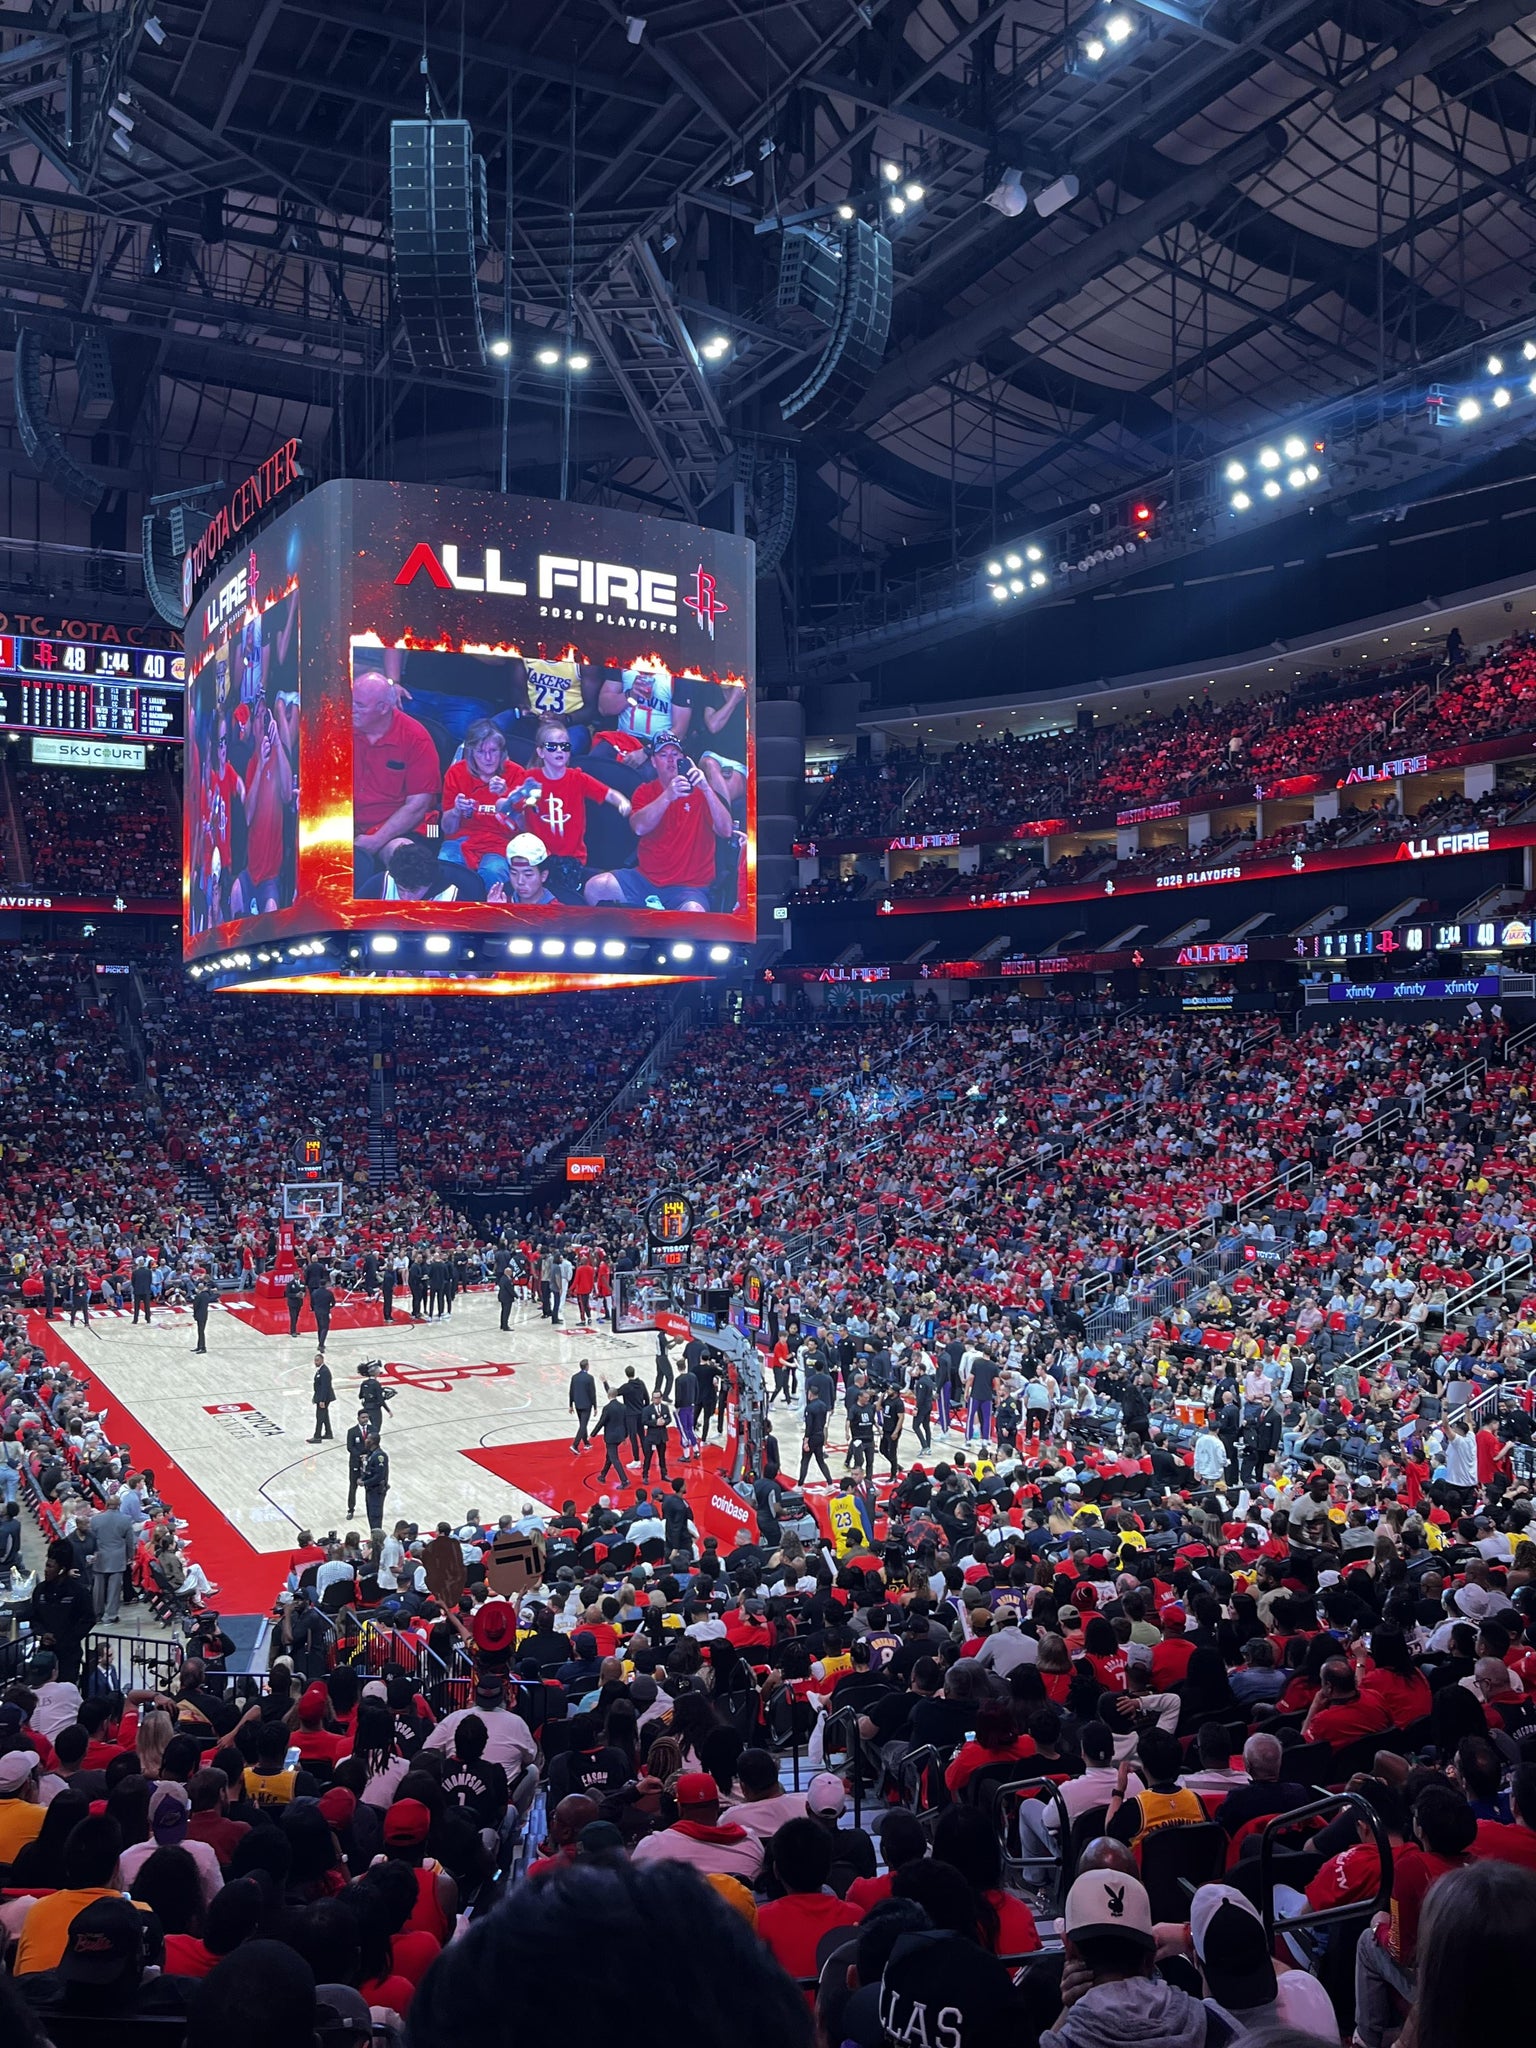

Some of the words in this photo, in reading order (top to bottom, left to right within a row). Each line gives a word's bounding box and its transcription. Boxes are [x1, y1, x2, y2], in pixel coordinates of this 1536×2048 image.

[193, 505, 230, 584] TOYOTA
[231, 437, 299, 532] CENTER
[394, 542, 527, 596] ALL
[539, 554, 677, 617] FIRE
[220, 567, 248, 622] FIRE
[540, 606, 584, 621] 2026
[596, 612, 678, 634] PLAYOFFS
[64, 647, 86, 671] 48
[101, 651, 130, 671] 1:44
[143, 655, 165, 678] 40
[535, 685, 565, 714] 23
[59, 745, 91, 756] SKY
[1346, 764, 1382, 785] ALL
[1382, 755, 1427, 779] FIRE
[890, 836, 923, 850] ALL
[922, 833, 960, 848] FIRE
[1395, 838, 1436, 860] ALL
[1437, 831, 1489, 855] FIRE
[1156, 874, 1183, 888] 2026
[1186, 867, 1241, 884] PLAYOFFS
[1406, 928, 1423, 951] 48
[1439, 925, 1461, 944] 1:44
[1477, 923, 1495, 946] 40
[1176, 946, 1208, 964] ALL
[1208, 943, 1248, 962] FIRE
[819, 968, 851, 982] ALL
[851, 966, 890, 981] FIRE
[1345, 984, 1376, 998] xfinity
[1393, 982, 1426, 997] xfinity
[1444, 979, 1480, 995] xfinity
[581, 1164, 601, 1173] PNC
[664, 1214, 683, 1238] 17
[663, 1244, 690, 1252] TISSOT
[213, 1414, 256, 1440] CENTER
[240, 1411, 286, 1437] TOYOTA
[711, 1494, 749, 1523] coinbase
[834, 1512, 852, 1528] 23
[442, 1773, 486, 1796] THOMPSON
[581, 1771, 608, 1787] EASON
